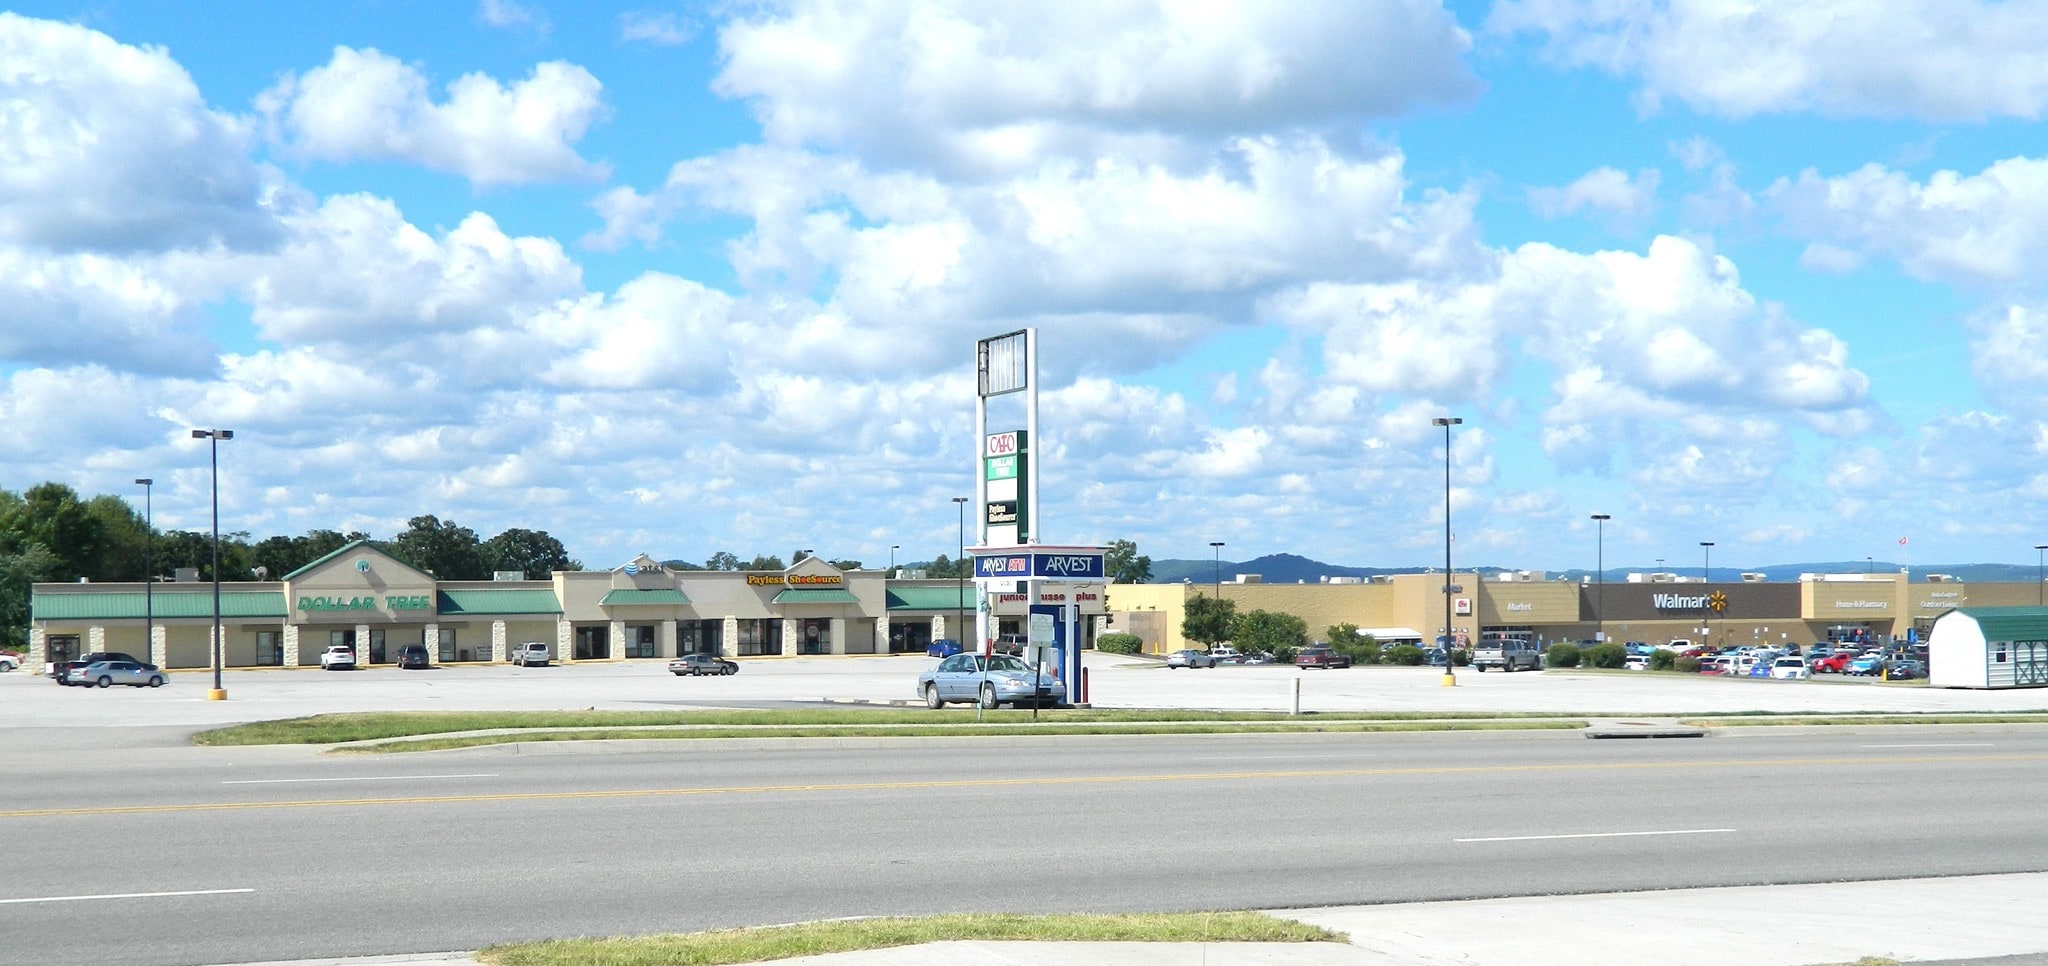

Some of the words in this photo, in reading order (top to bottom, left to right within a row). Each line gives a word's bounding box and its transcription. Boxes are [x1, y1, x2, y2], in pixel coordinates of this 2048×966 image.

[990, 434, 1015, 453] CATO
[982, 557, 1007, 577] ARVEST
[1007, 558, 1026, 572] ATM
[1045, 556, 1093, 576] ARVEST
[748, 575, 785, 587] Payless
[789, 574, 842, 585] ShoeSource
[298, 596, 375, 611] DOLLAR
[384, 596, 430, 609] TREE
[1076, 591, 1097, 603] plus
[1653, 593, 1711, 609] Walmart
[1508, 602, 1532, 611] Market
